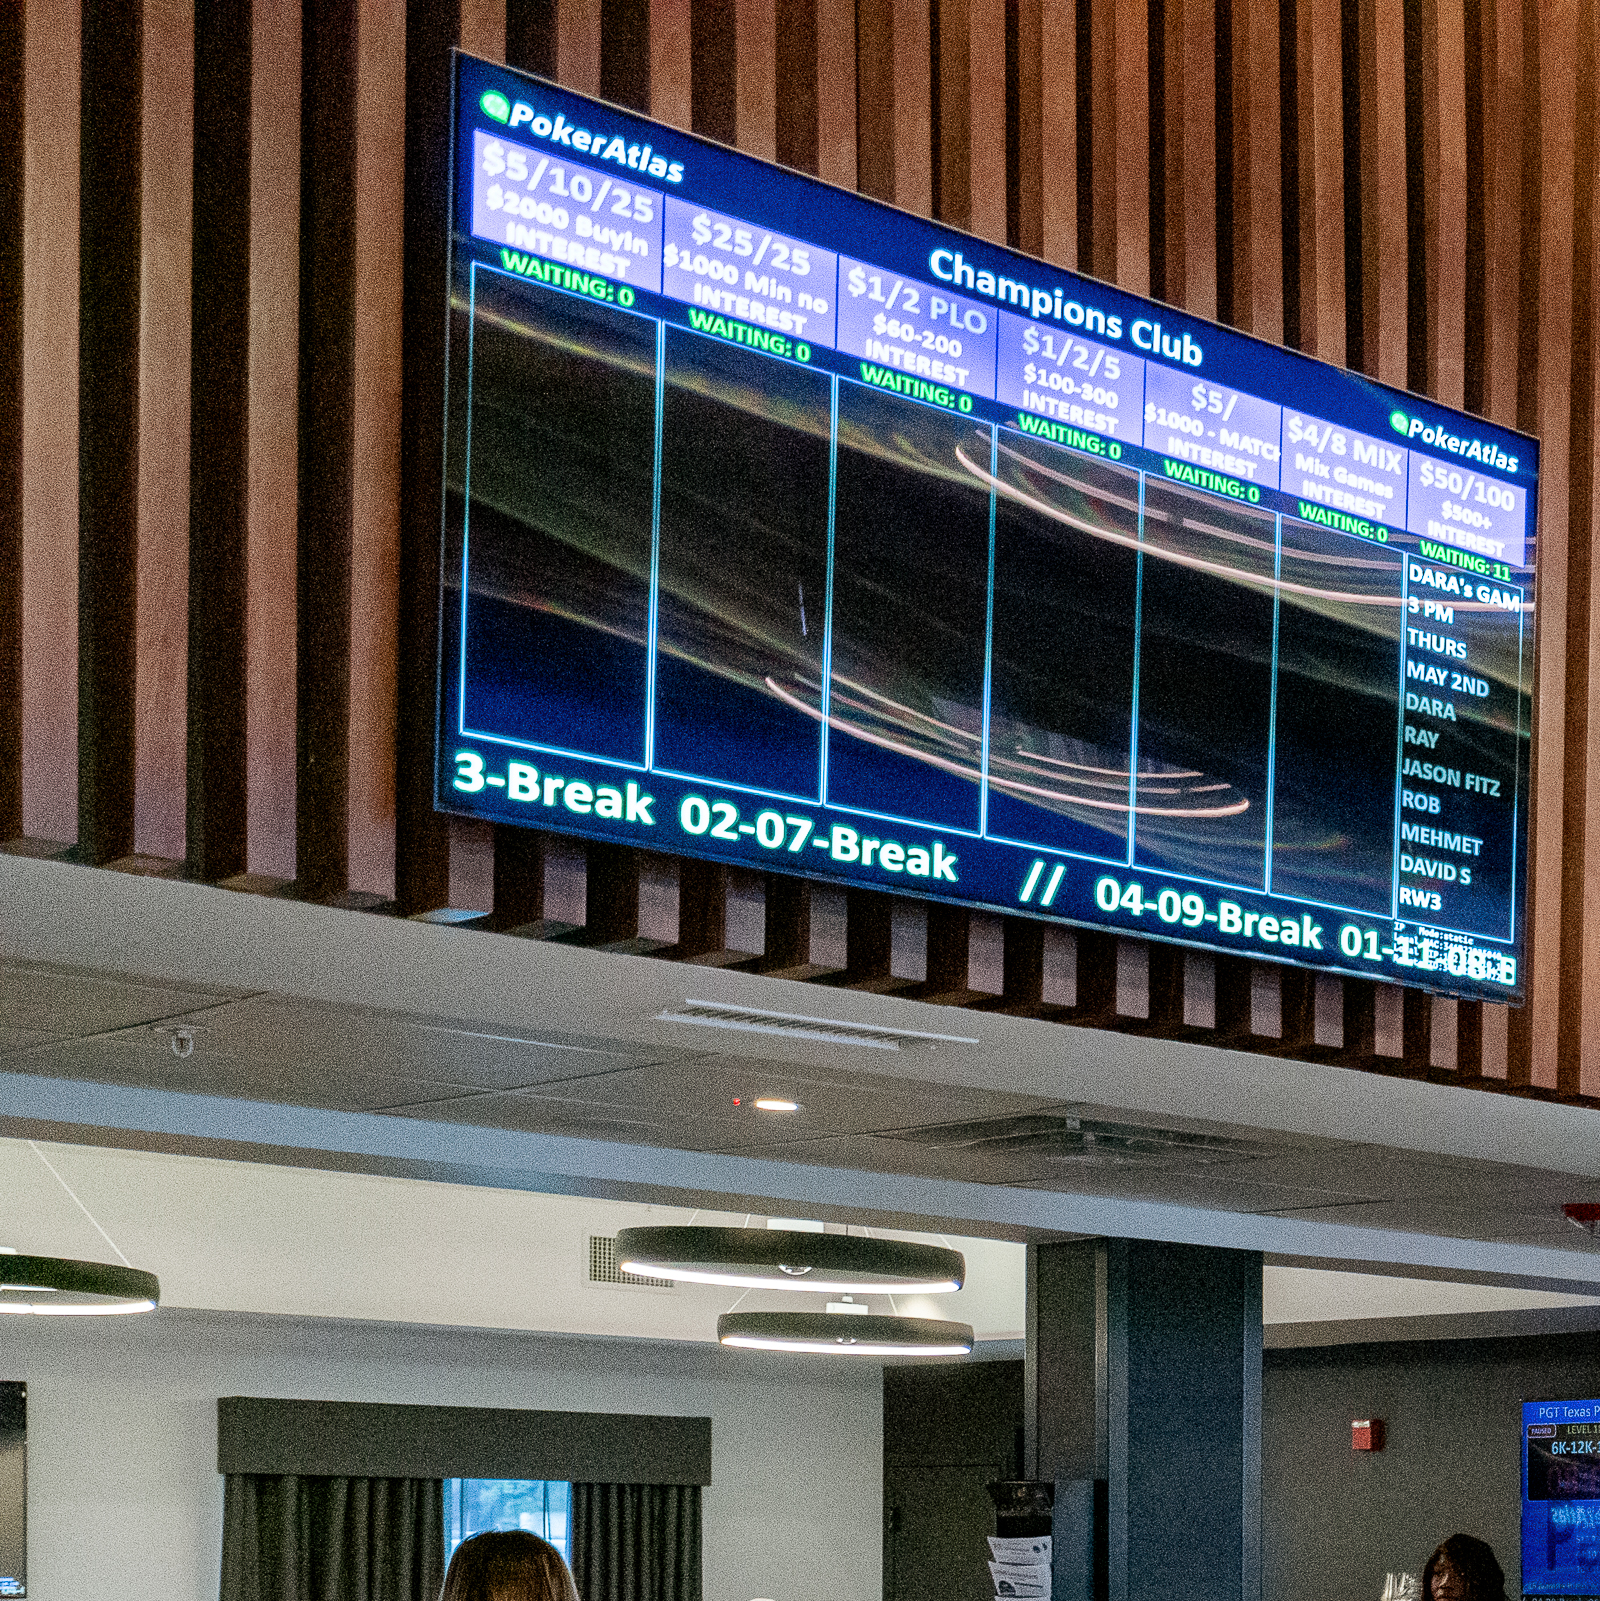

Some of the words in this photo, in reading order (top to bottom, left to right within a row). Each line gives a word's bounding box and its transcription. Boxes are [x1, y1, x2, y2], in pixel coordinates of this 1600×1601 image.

[510, 102, 685, 184] PokerAtlas
[482, 140, 654, 223] $5/10/25
[487, 185, 569, 229] $2000
[505, 222, 631, 279] INTEREST
[692, 214, 811, 277] $25/25
[501, 250, 613, 301] WAITING:
[619, 287, 634, 308] 0
[664, 243, 738, 286] $1000
[797, 292, 829, 316] no
[693, 284, 807, 336] INTEREST
[848, 267, 921, 315] $1/2
[930, 295, 987, 336] PLO
[928, 250, 1121, 341] Champions
[1131, 320, 1202, 367] Club
[688, 308, 790, 358] WAITING:
[796, 343, 811, 364] 0
[873, 314, 963, 359] $60-200
[1022, 329, 1121, 381] $1/2/5
[865, 339, 970, 387] INTEREST
[860, 362, 955, 407] WAITING:
[959, 393, 973, 413] 0
[1024, 363, 1119, 411] $100-300
[1191, 384, 1238, 421] $5/
[1022, 390, 1119, 438] INTEREST
[1144, 402, 1203, 440] $1000
[1019, 413, 1104, 457] WAITING:
[1108, 440, 1122, 460] 0
[1167, 436, 1258, 479] INTEREST
[1287, 414, 1348, 460] $4/8
[1352, 438, 1402, 477] MIX
[1407, 418, 1519, 474] PokerAtlas
[1164, 459, 1243, 499] WAITING:
[1247, 482, 1260, 503] 0
[1302, 480, 1386, 521] INTEREST
[1334, 466, 1394, 500] Games
[1420, 460, 1516, 513] $50/100
[1299, 502, 1372, 540] WAITING:
[1376, 527, 1388, 543] 0
[1441, 500, 1493, 530] $500+
[1428, 521, 1505, 557] INTEREST
[1420, 541, 1491, 575] WAITING:
[1493, 564, 1511, 582] 11
[1409, 563, 1473, 598] DARA's
[1477, 586, 1520, 612] GAM
[1408, 596, 1419, 614] 3
[1425, 602, 1454, 624] PM
[1407, 628, 1467, 659] THURS
[1407, 660, 1449, 687] MAY
[1451, 672, 1490, 698] 2ND
[1406, 693, 1457, 721] DARA
[1405, 725, 1440, 749] RAY
[1403, 758, 1461, 787] JASON
[1465, 773, 1501, 797] FITZ
[1402, 789, 1441, 814] ROB
[454, 750, 655, 824] 3-Break
[681, 796, 958, 881] 02-07-Break
[1096, 878, 1322, 951] 04-09-Break
[1401, 822, 1483, 856] MEHMET
[1401, 854, 1457, 882] DAVID
[1460, 867, 1472, 886] S
[1400, 886, 1442, 911] RW3
[1539, 1407, 1559, 1419] PGT
[1564, 1407, 1590, 1417] Texas
